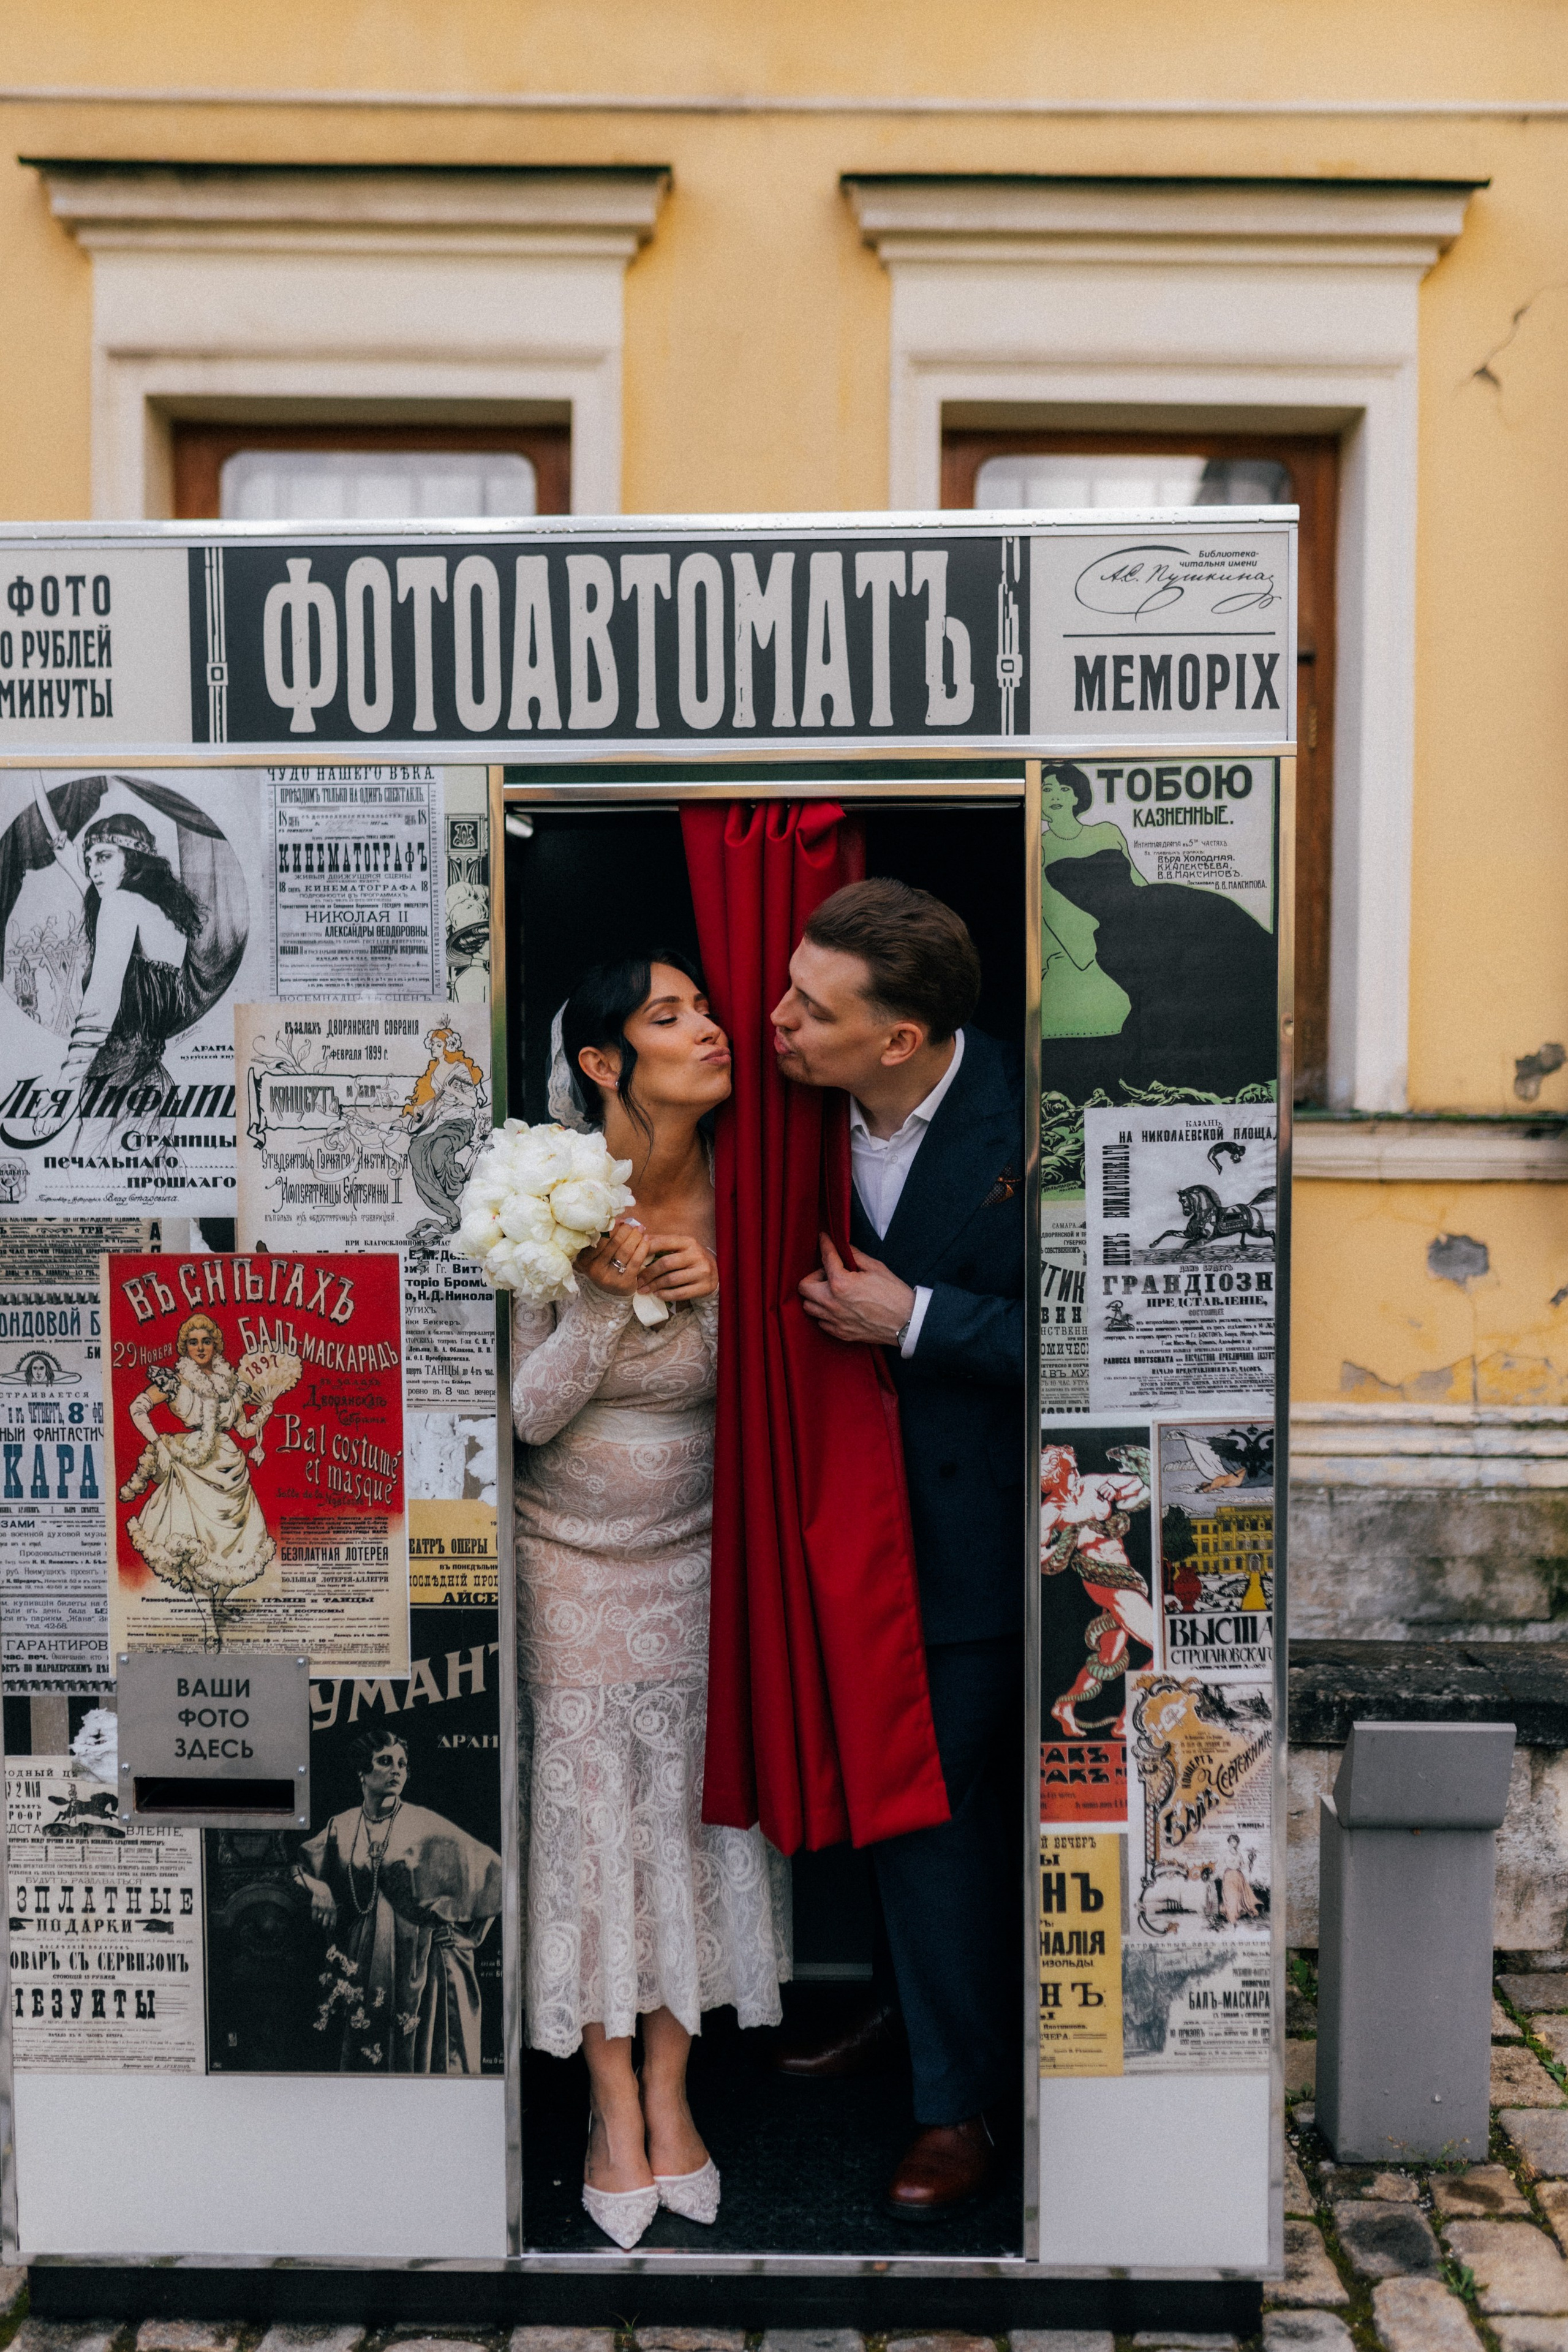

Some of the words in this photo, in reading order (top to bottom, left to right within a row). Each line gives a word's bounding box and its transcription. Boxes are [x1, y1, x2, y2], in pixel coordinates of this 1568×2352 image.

[7, 575, 111, 617] ФОТО
[22, 624, 112, 668] РУБЛЕЙ
[263, 551, 974, 733] ФОТОАВТОМАТЪ
[0, 679, 113, 718] МИНУТЫ
[1097, 764, 1253, 804] ТОБОЮ
[1133, 805, 1234, 827] КАЗНЕННЫЕ.
[279, 842, 428, 873] КИНЕМАТОГРАФЪ
[306, 911, 390, 922] НИКОЛАЯ
[399, 911, 408, 922] II
[325, 925, 374, 938] АЛЕКСАНДРЫ
[365, 1045, 382, 1060] 1899
[270, 1086, 339, 1121] КОНЦЕРТЪ
[1119, 1131, 1133, 1144] НА
[1142, 1126, 1224, 1142] НИКОЛАЕВСКОЙ
[1102, 1144, 1130, 1218] КОМАРОВСКАГО
[1102, 1233, 1133, 1265] ЦИРКЪ
[1102, 1272, 1273, 1296] ГРАНДІОЗН
[1147, 1295, 1268, 1308] ПРЕДСТАВЛЕНІЕ,
[112, 1341, 138, 1368] 29
[244, 1354, 279, 1381] 1897
[425, 1365, 459, 1377] ТАНЦЫ
[275, 1414, 326, 1455] Bal
[332, 1434, 402, 1479] costumé
[3, 1444, 99, 1499] КАРА
[306, 1457, 320, 1485] et
[328, 1464, 398, 1507] masqué
[281, 1547, 340, 1561] БЕЗПЛАТНАЯ
[345, 1547, 389, 1561] ЛОТЕРЕЯ
[451, 1538, 488, 1554] ОПЕРЫ
[6, 1640, 108, 1651] ГАРАНТИРОВ
[177, 1678, 251, 1698] ВАШИ
[177, 1708, 249, 1729] ФОТО
[175, 1738, 254, 1760] ЗДЕСЬ
[1182, 1754, 1214, 1789] КОНЦЕРТЪ
[1054, 1836, 1096, 1849] ВЕЧЕРЪ
[17, 1885, 193, 1915] ЗПЛАТНЫЕ
[1042, 1872, 1104, 1913] НЪ
[37, 1918, 132, 1936] ПОДАРКИ
[69, 1951, 89, 1970] СЪ
[97, 1951, 189, 1973] СЕРВИЗОМЪ
[15, 1988, 156, 2020] ІЕЗУИТЫ
[1178, 2029, 1205, 2038] ПРИЗОВЪ
